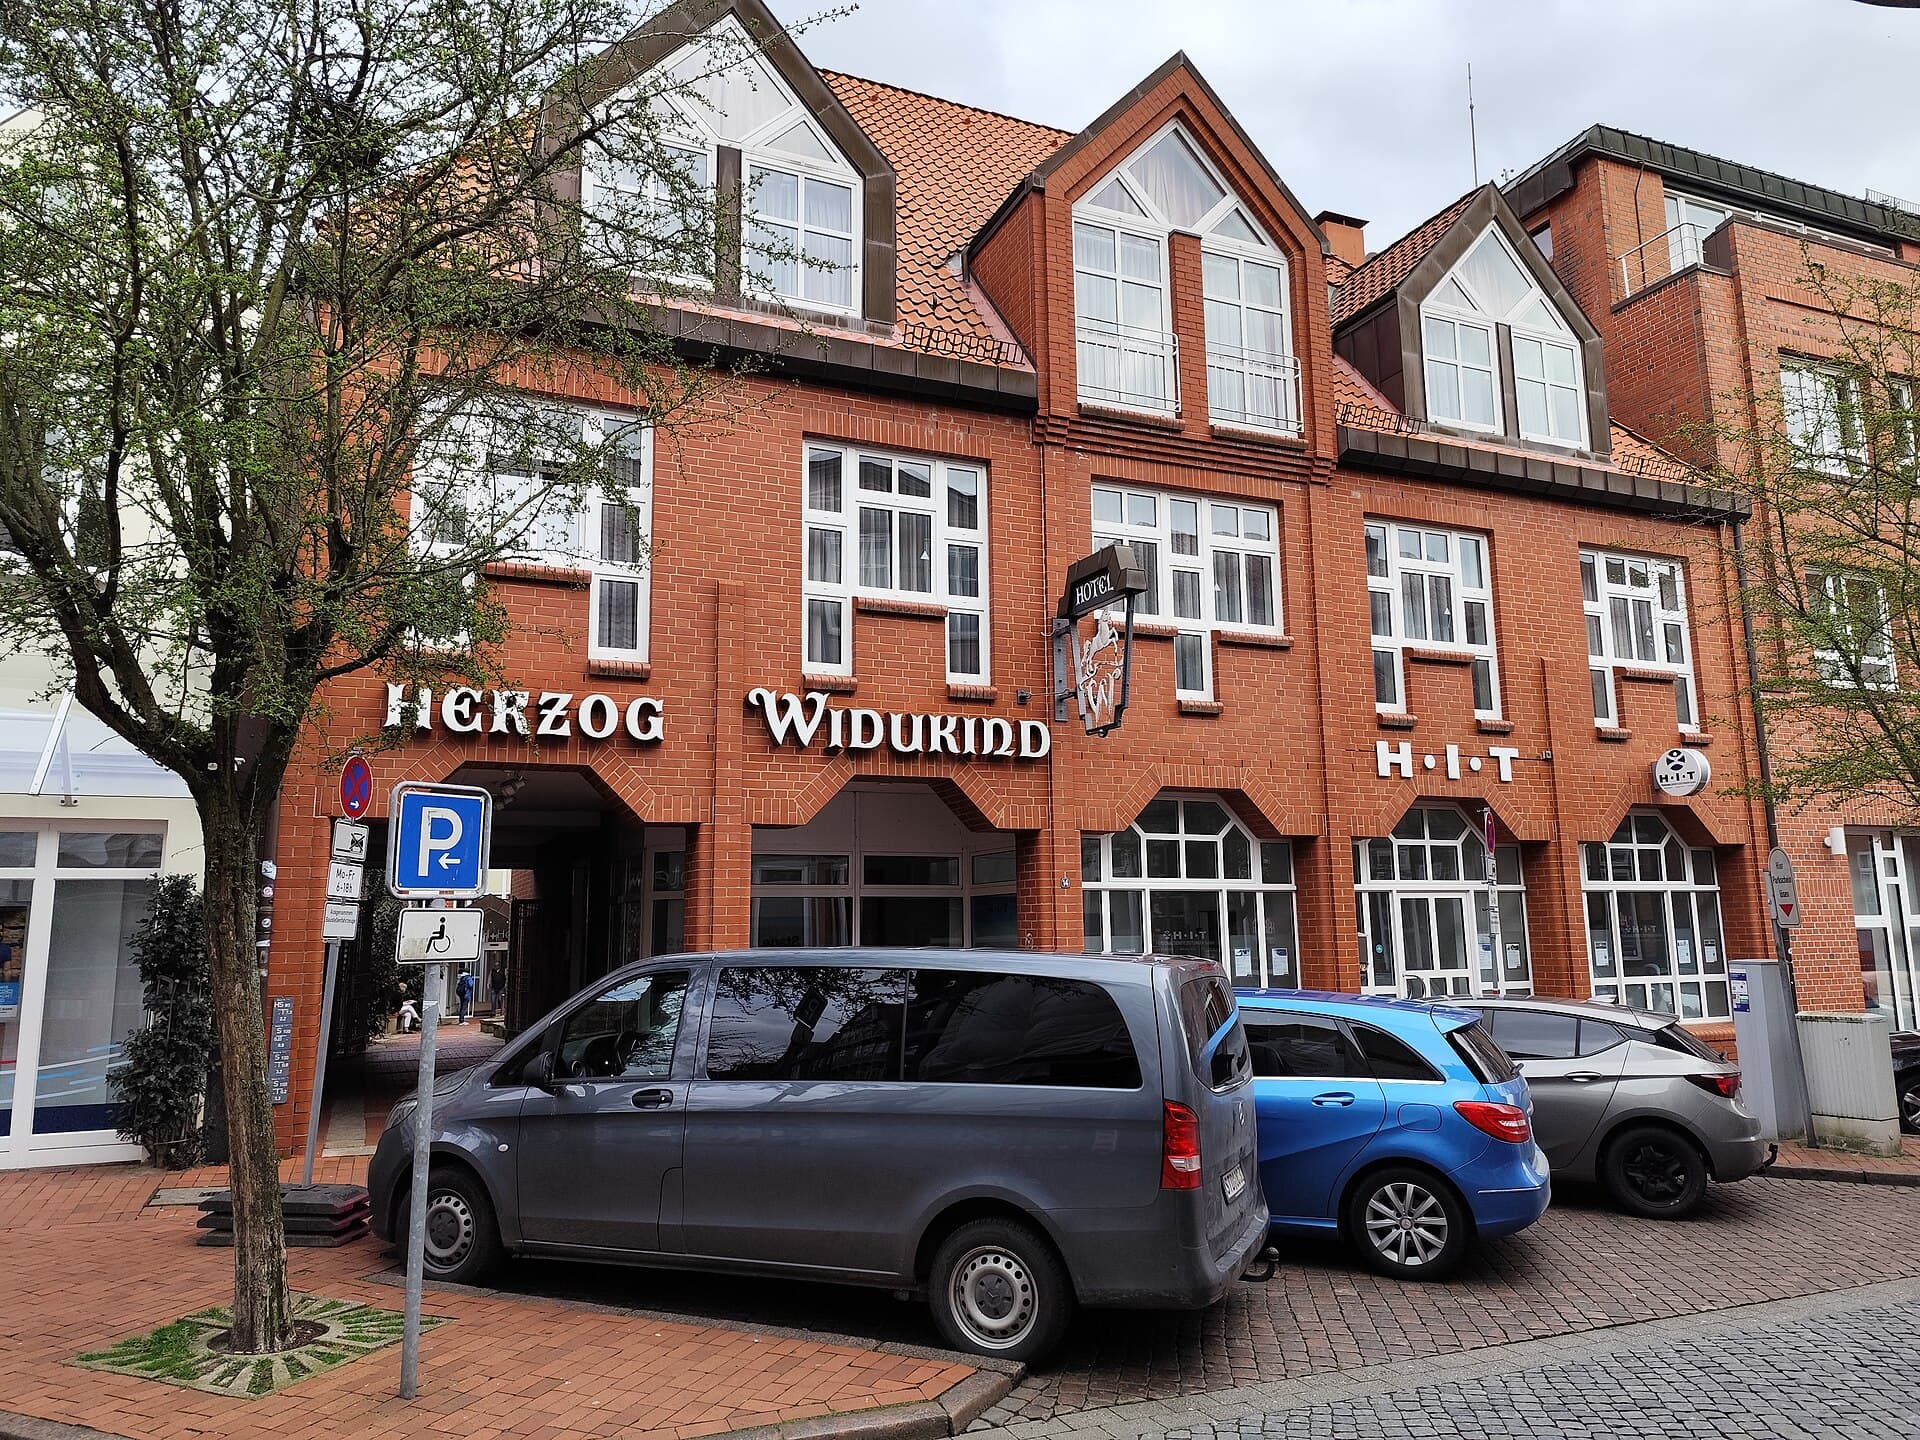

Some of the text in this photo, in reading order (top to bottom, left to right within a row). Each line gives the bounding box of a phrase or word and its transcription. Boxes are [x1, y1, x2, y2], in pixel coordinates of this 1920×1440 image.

[1075, 572, 1114, 605] HOTEL
[384, 682, 665, 741] HERZOG
[418, 806, 463, 877] P
[335, 868, 356, 881] Mo-Fr
